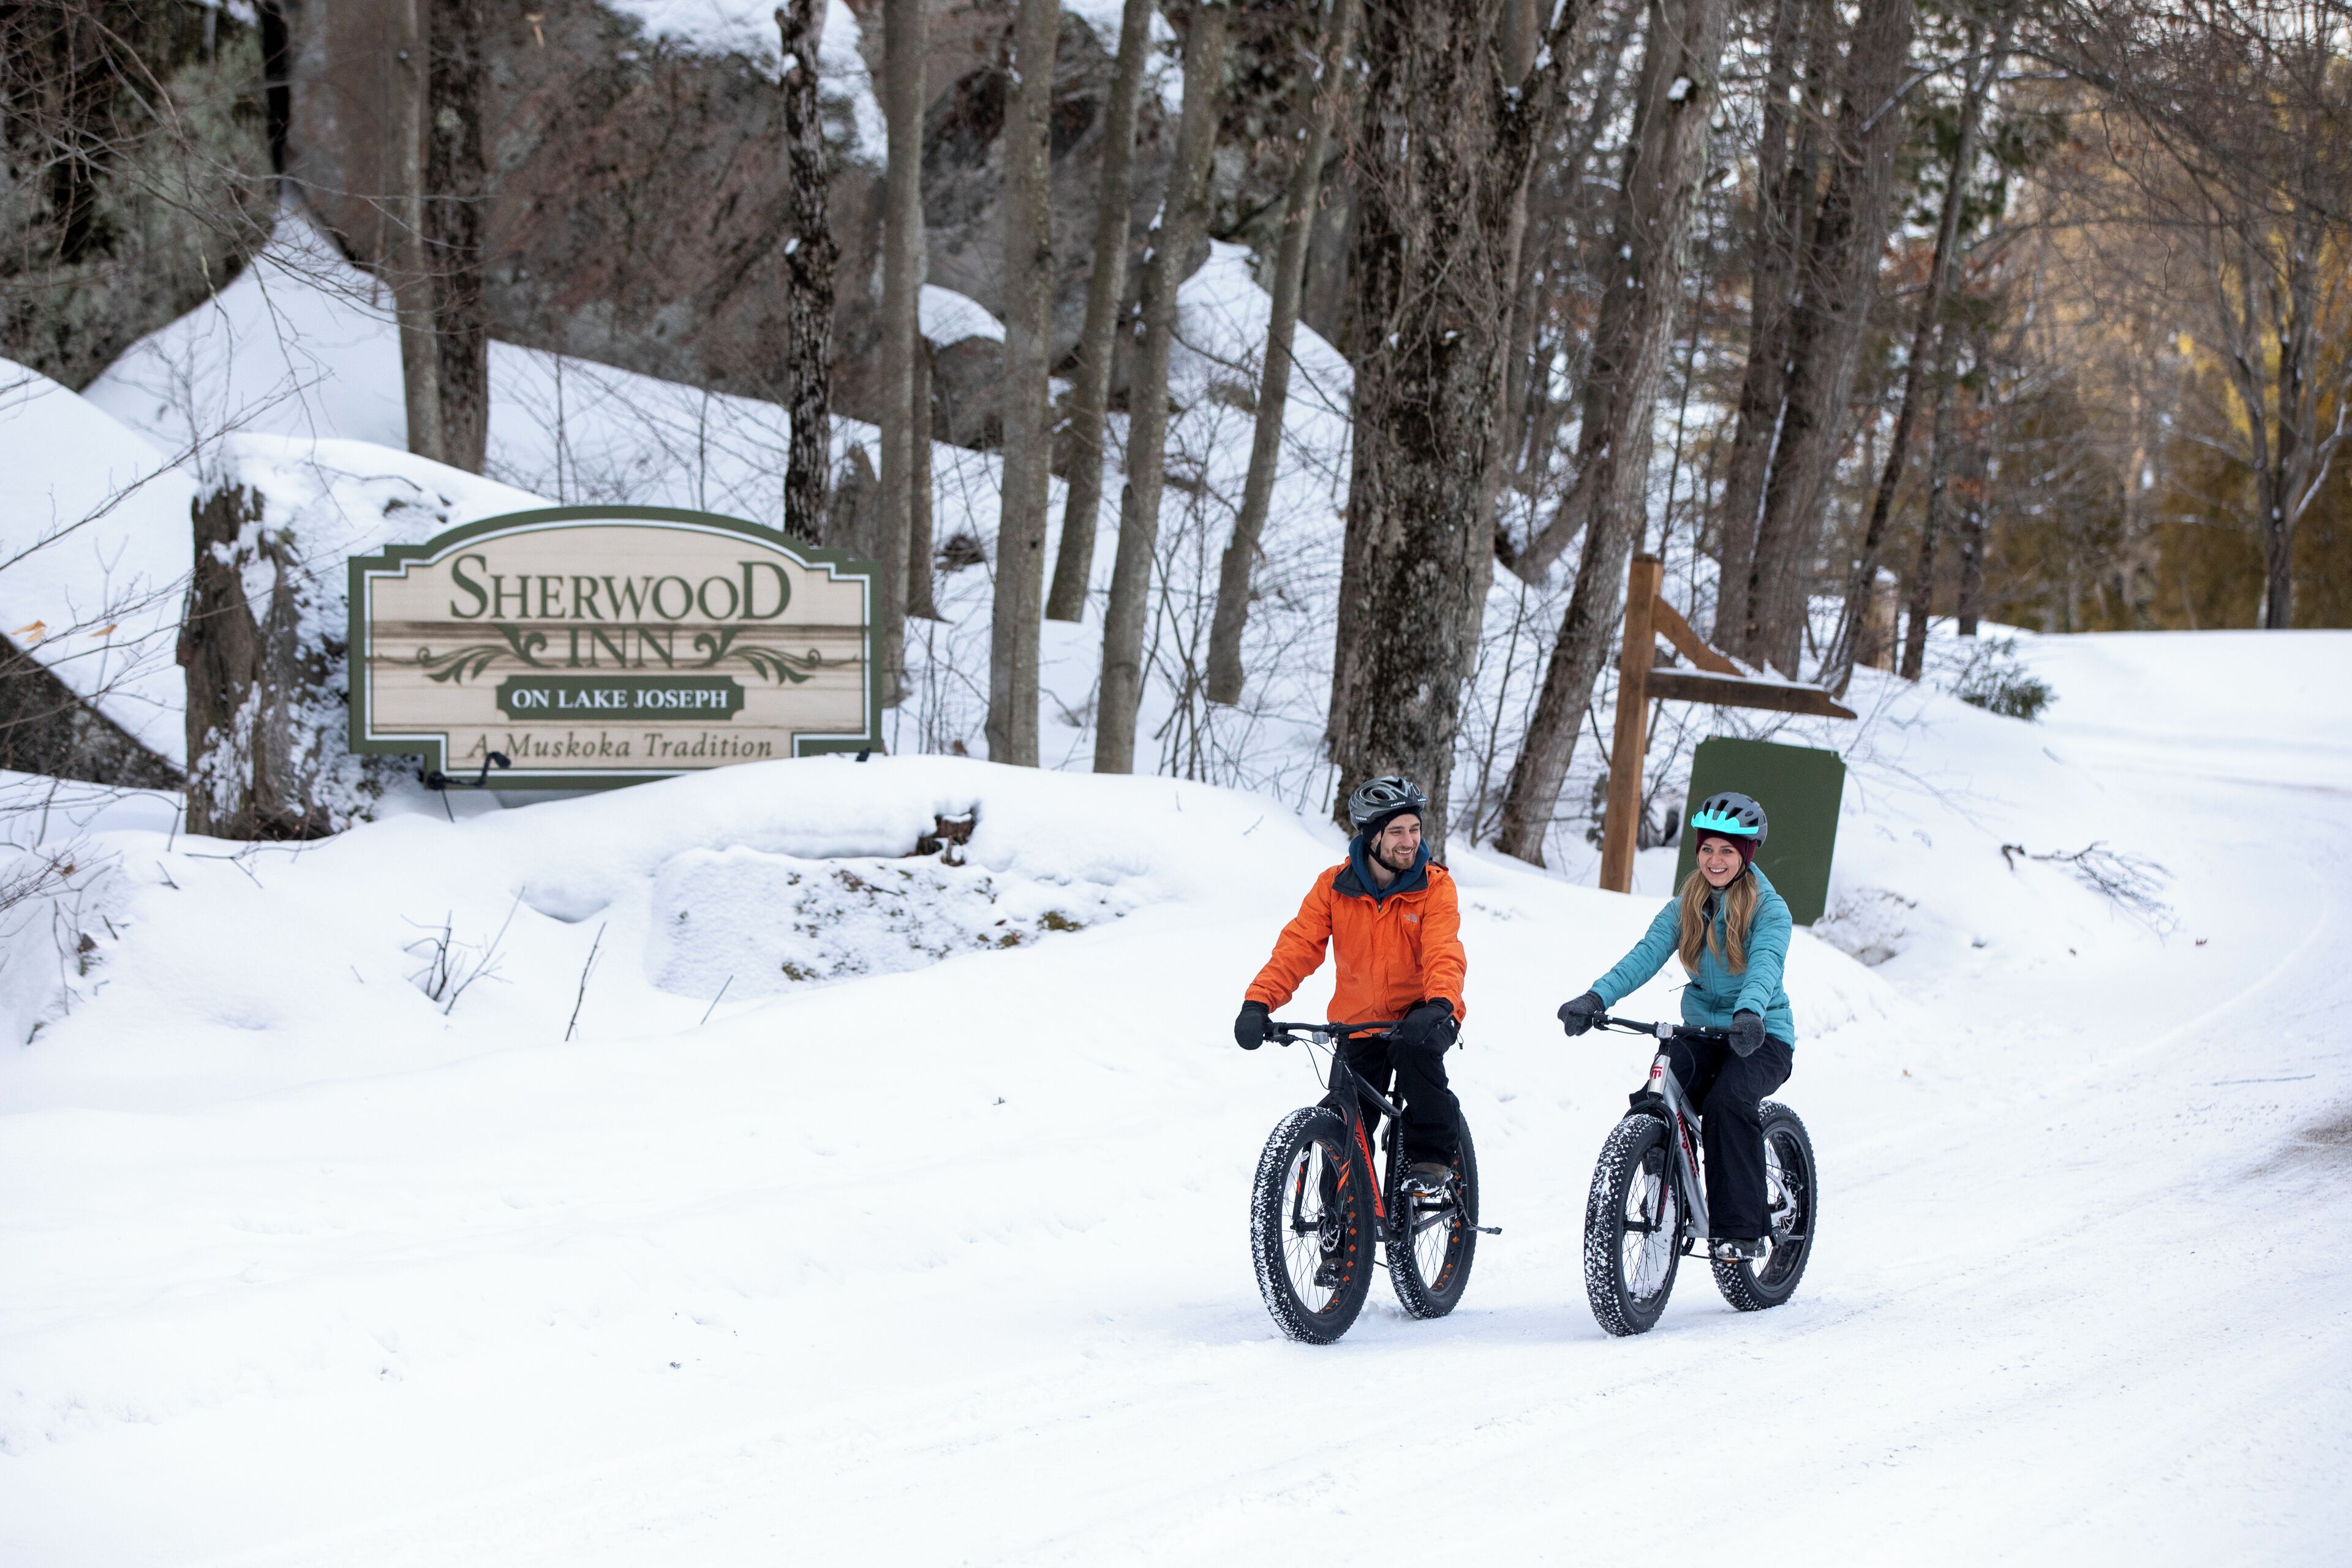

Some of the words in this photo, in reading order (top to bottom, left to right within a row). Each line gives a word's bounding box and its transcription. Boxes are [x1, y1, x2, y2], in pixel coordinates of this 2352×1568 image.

[450, 554, 791, 620] SHERWOOD
[566, 627, 674, 668] INN
[511, 689, 549, 709] ON
[557, 690, 628, 709] LAKE
[633, 690, 728, 709] JOSEPH
[467, 733, 491, 759] A
[504, 732, 630, 758] Muskoka
[644, 733, 772, 758] Tradition
